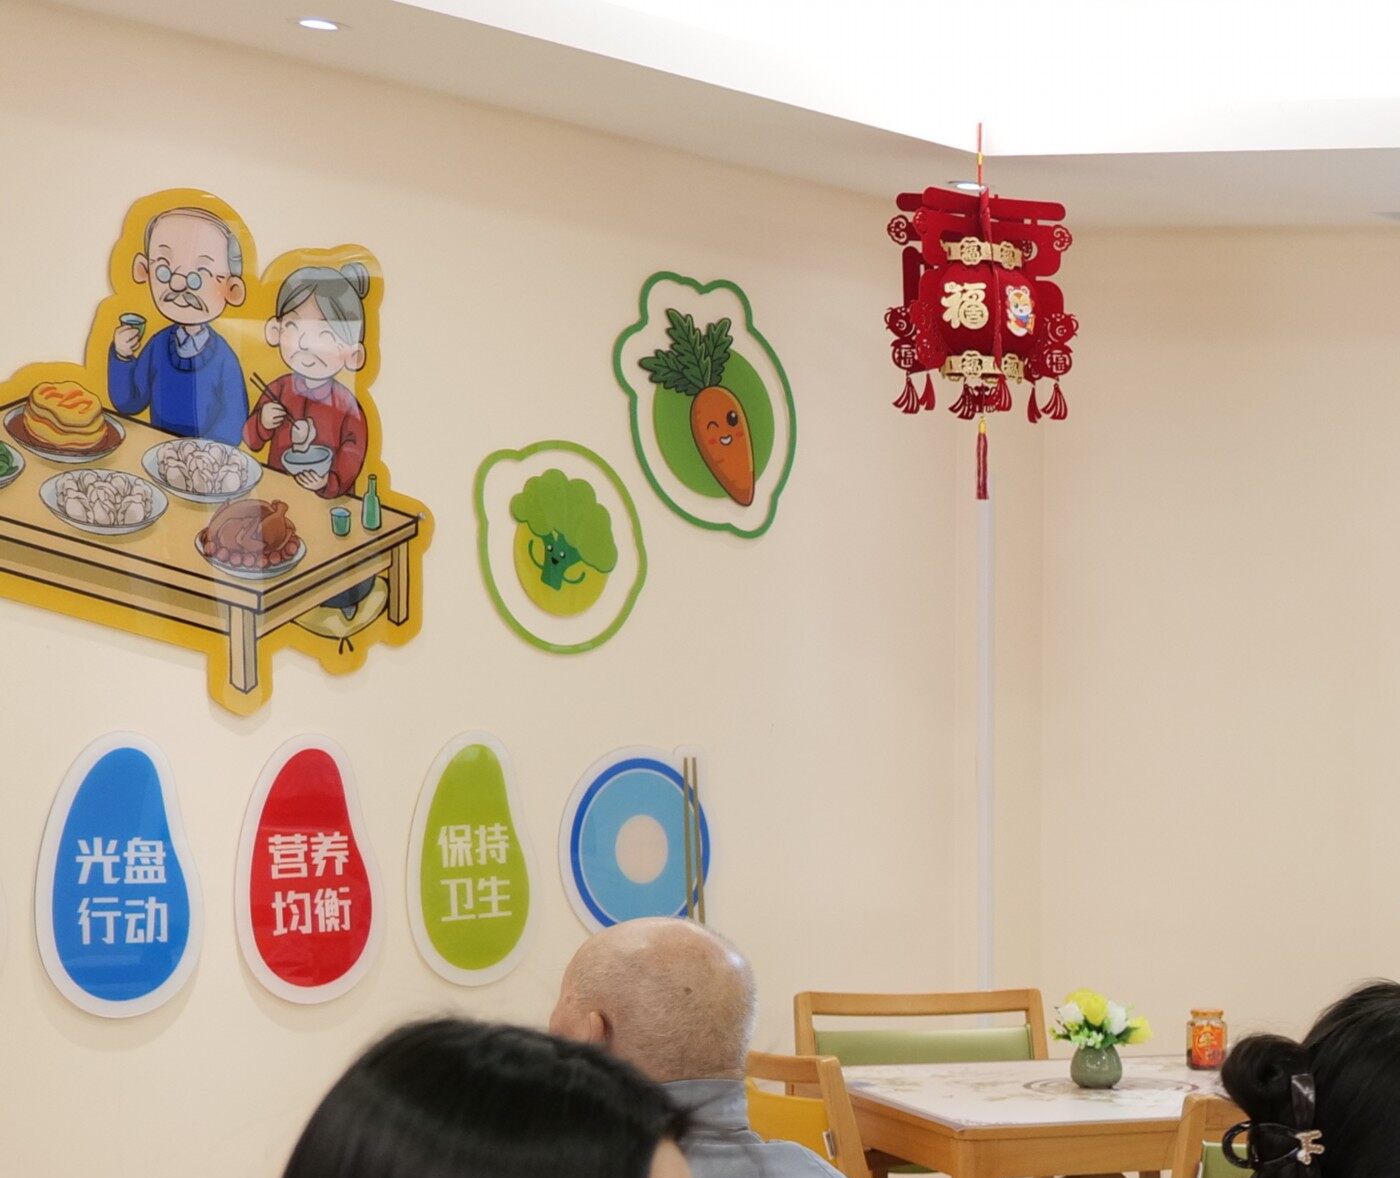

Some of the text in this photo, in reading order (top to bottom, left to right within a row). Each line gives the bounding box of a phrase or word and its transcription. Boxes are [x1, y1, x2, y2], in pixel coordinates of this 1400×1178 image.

[940, 281, 989, 330] 福
[75, 837, 166, 885] 光盘
[268, 831, 350, 879] 营养
[438, 823, 510, 869] 保持
[77, 896, 168, 945] 行动
[271, 886, 352, 936] 均衡
[440, 876, 513, 922] 卫生
